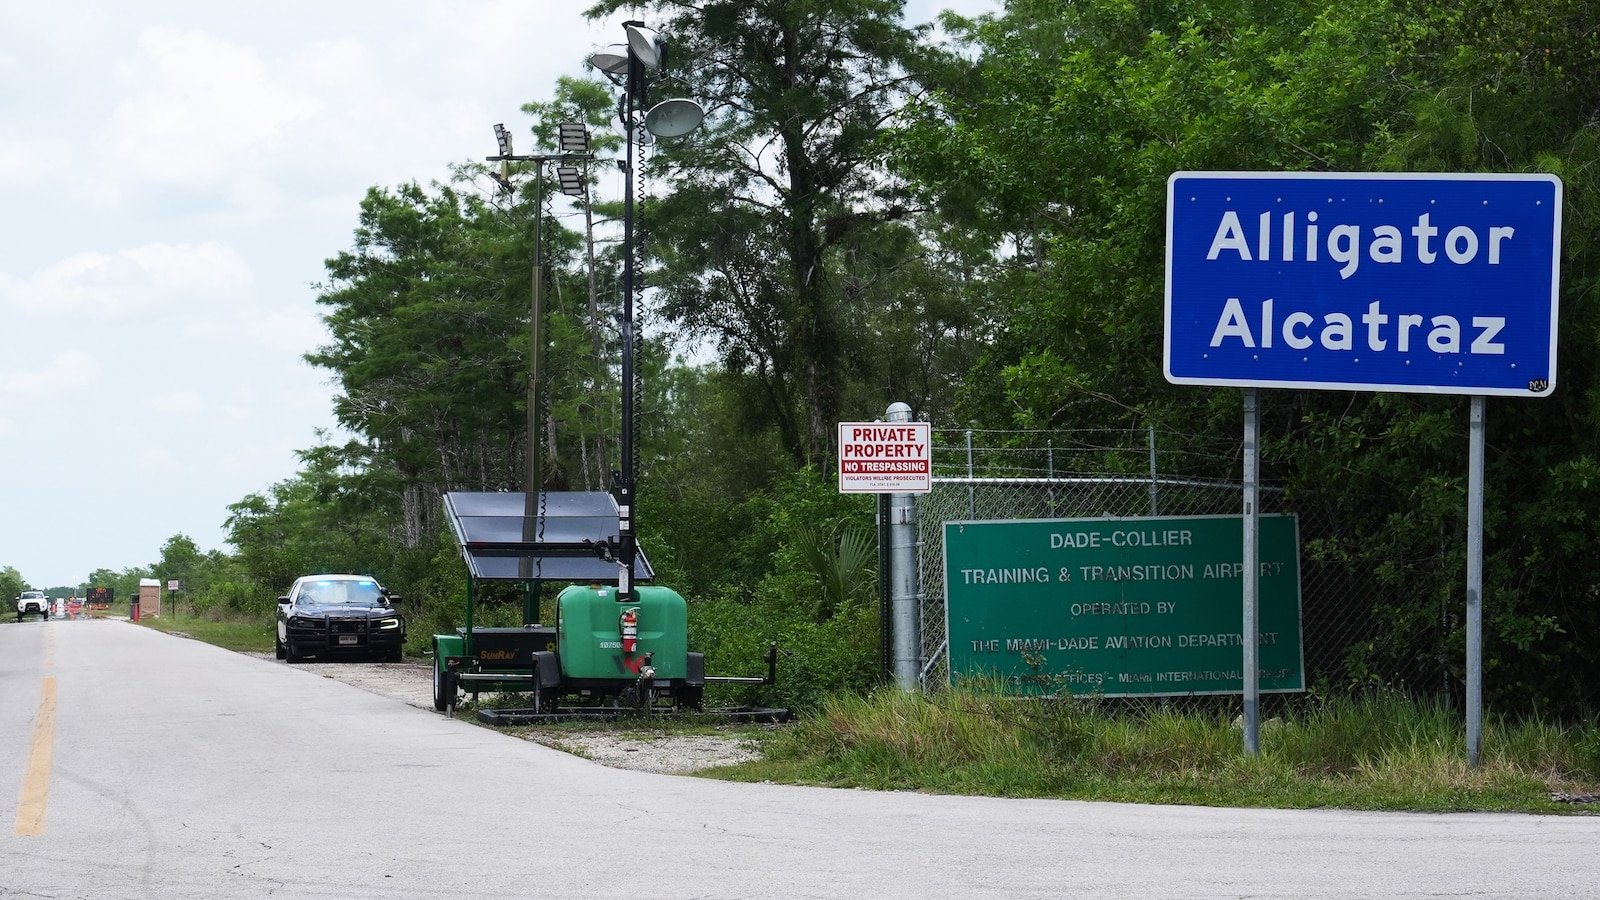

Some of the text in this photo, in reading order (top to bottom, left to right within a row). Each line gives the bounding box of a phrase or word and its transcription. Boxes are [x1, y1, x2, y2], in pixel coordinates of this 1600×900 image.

[1206, 210, 1515, 280] Alligator
[1209, 297, 1506, 355] Alcatraz
[853, 428, 916, 442] PRIVATE
[844, 444, 925, 457] PROPERTY
[845, 462, 926, 471] NO TRESPASSING
[1050, 530, 1193, 549] DADE-COLLIER
[961, 561, 1285, 584] TRAINING & TRANSITION AIRPRT
[1071, 601, 1176, 616] OPERATED BY
[600, 641, 624, 649] 10750
[971, 632, 1279, 653] THE MIAMI-DADE AVIATION DEPARTMNT
[1118, 672, 1153, 683] MIAMI
[1156, 670, 1243, 682] INTERNATIONAL
